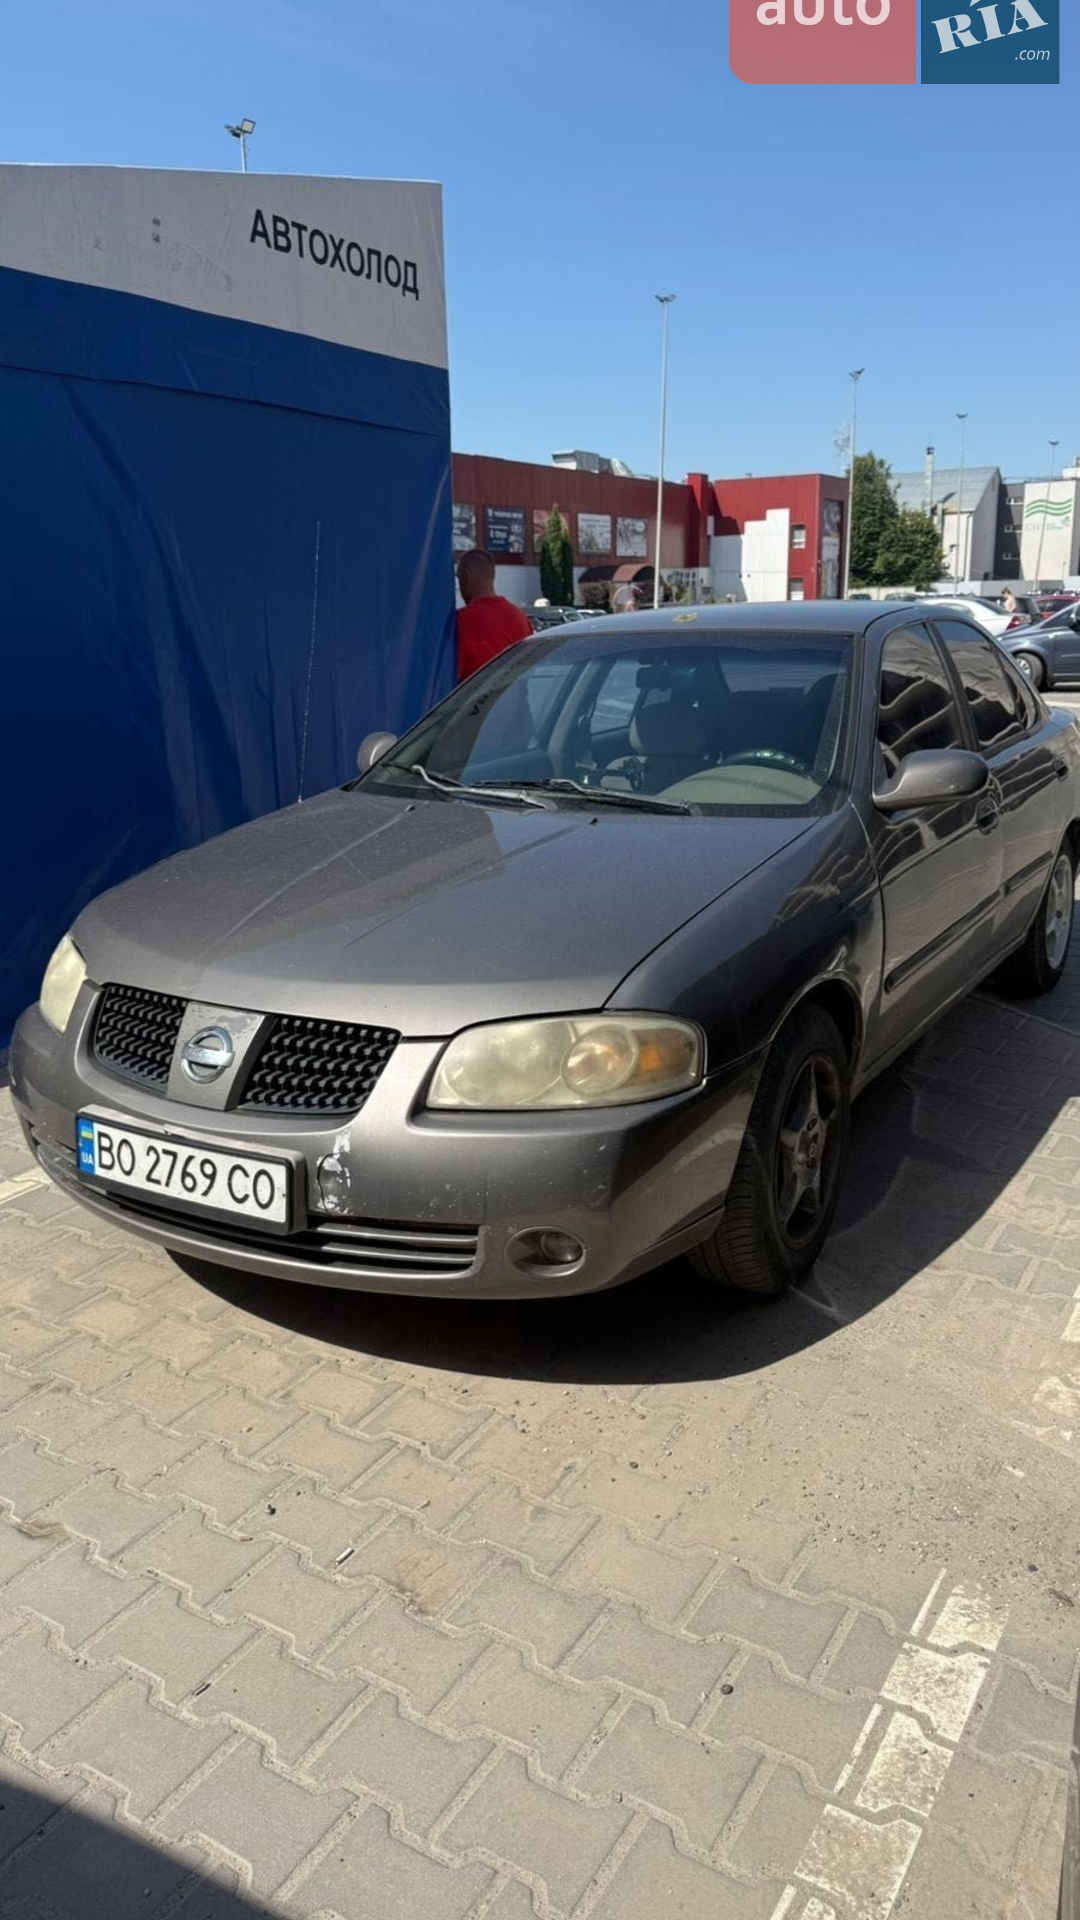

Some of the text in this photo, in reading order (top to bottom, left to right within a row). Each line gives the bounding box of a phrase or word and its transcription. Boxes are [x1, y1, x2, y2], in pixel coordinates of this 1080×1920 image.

[250, 208, 420, 301] АВТОХОЛОД
[81, 1151, 94, 1165] UA
[97, 1131, 275, 1210] BO 2769 CO
